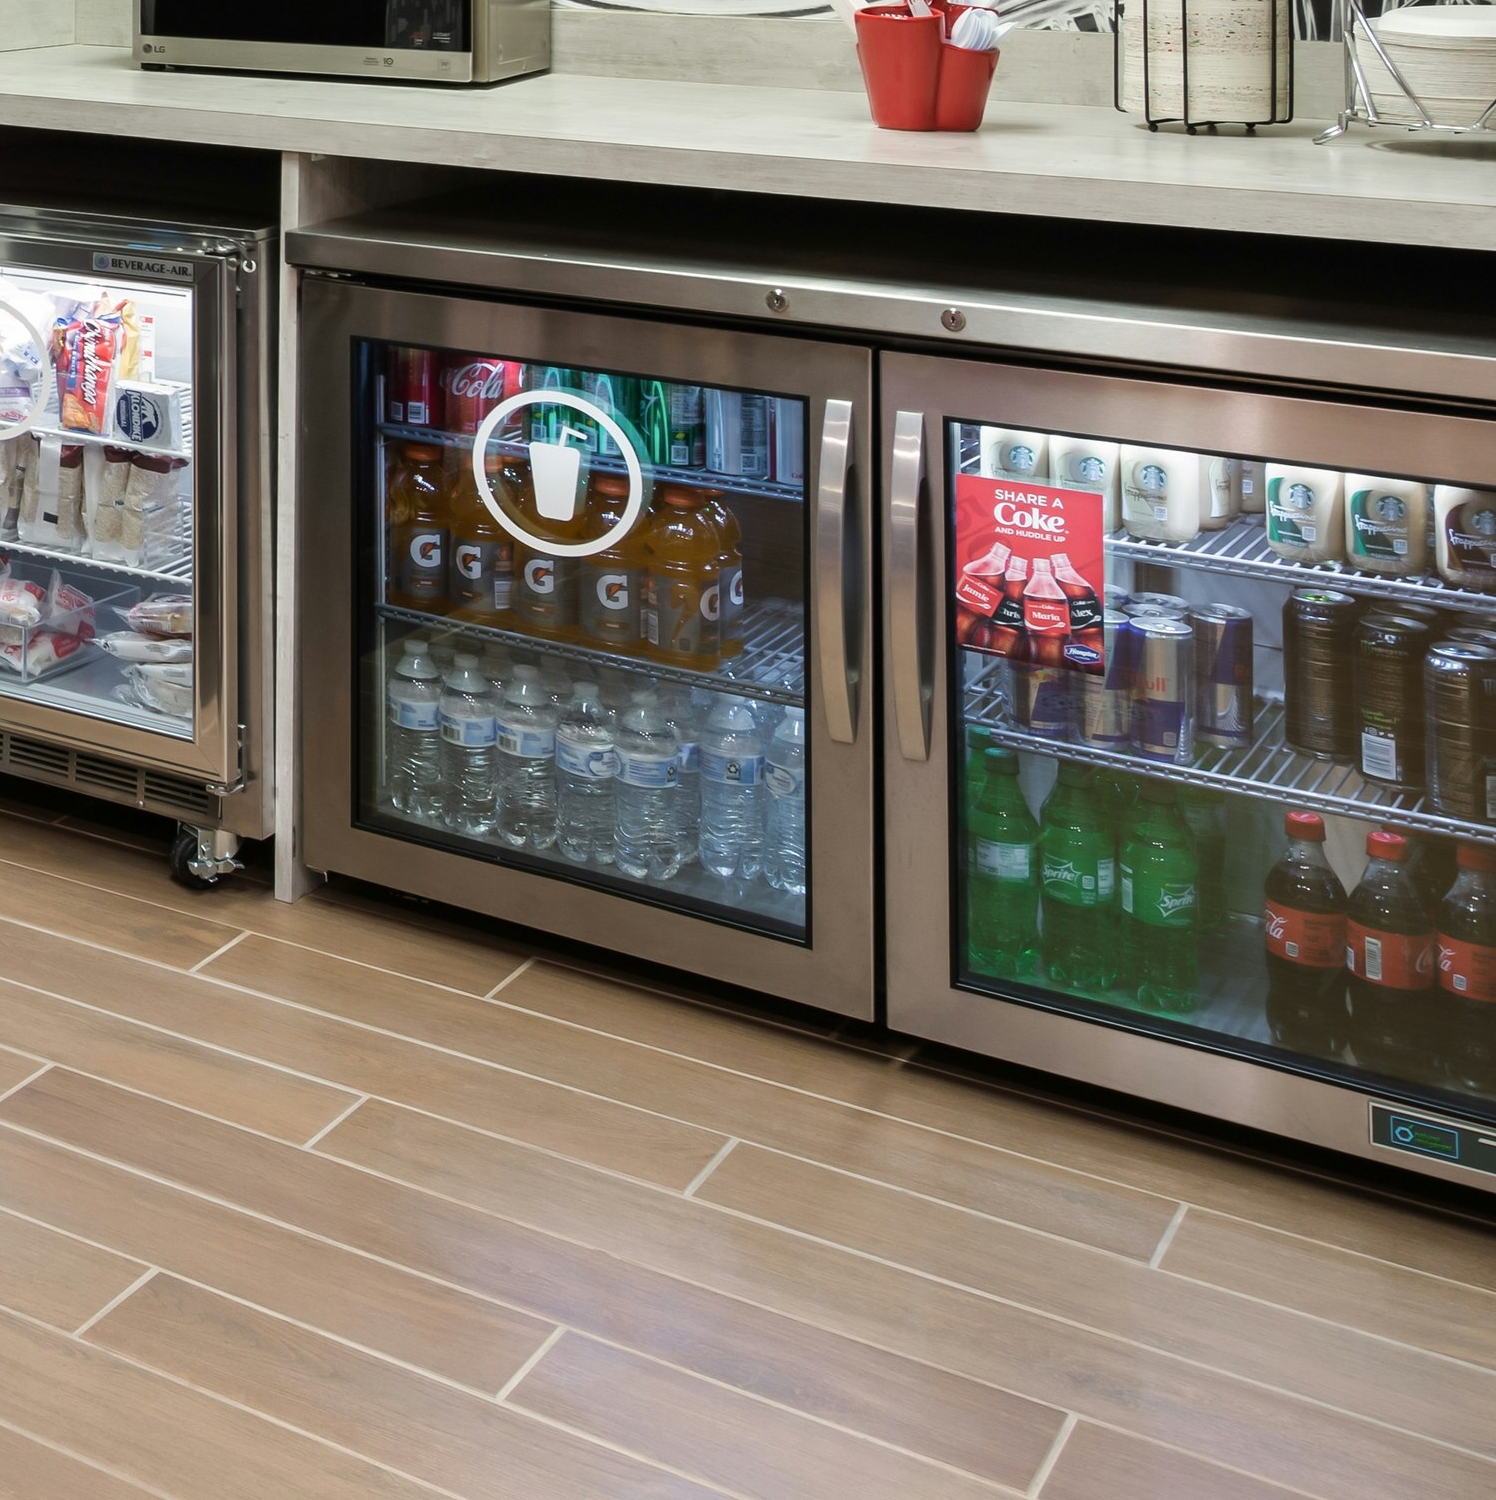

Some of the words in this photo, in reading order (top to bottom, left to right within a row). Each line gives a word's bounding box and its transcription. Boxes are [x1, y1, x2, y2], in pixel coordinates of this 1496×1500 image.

[111, 257, 191, 277] BEVERAGE-AIR
[450, 362, 505, 398] Cola
[994, 489, 1047, 507] SHARE
[1052, 498, 1064, 509] A
[993, 502, 1066, 534] Coke
[994, 526, 1014, 535] AND
[1015, 529, 1052, 542] HUDDLE
[1053, 535, 1066, 543] UP
[410, 534, 442, 568] G
[456, 545, 481, 579] G
[525, 560, 555, 593] G
[597, 574, 629, 609] G
[962, 583, 990, 604] Jamie
[1032, 611, 1060, 622] Maria
[1044, 862, 1075, 881] Sprite
